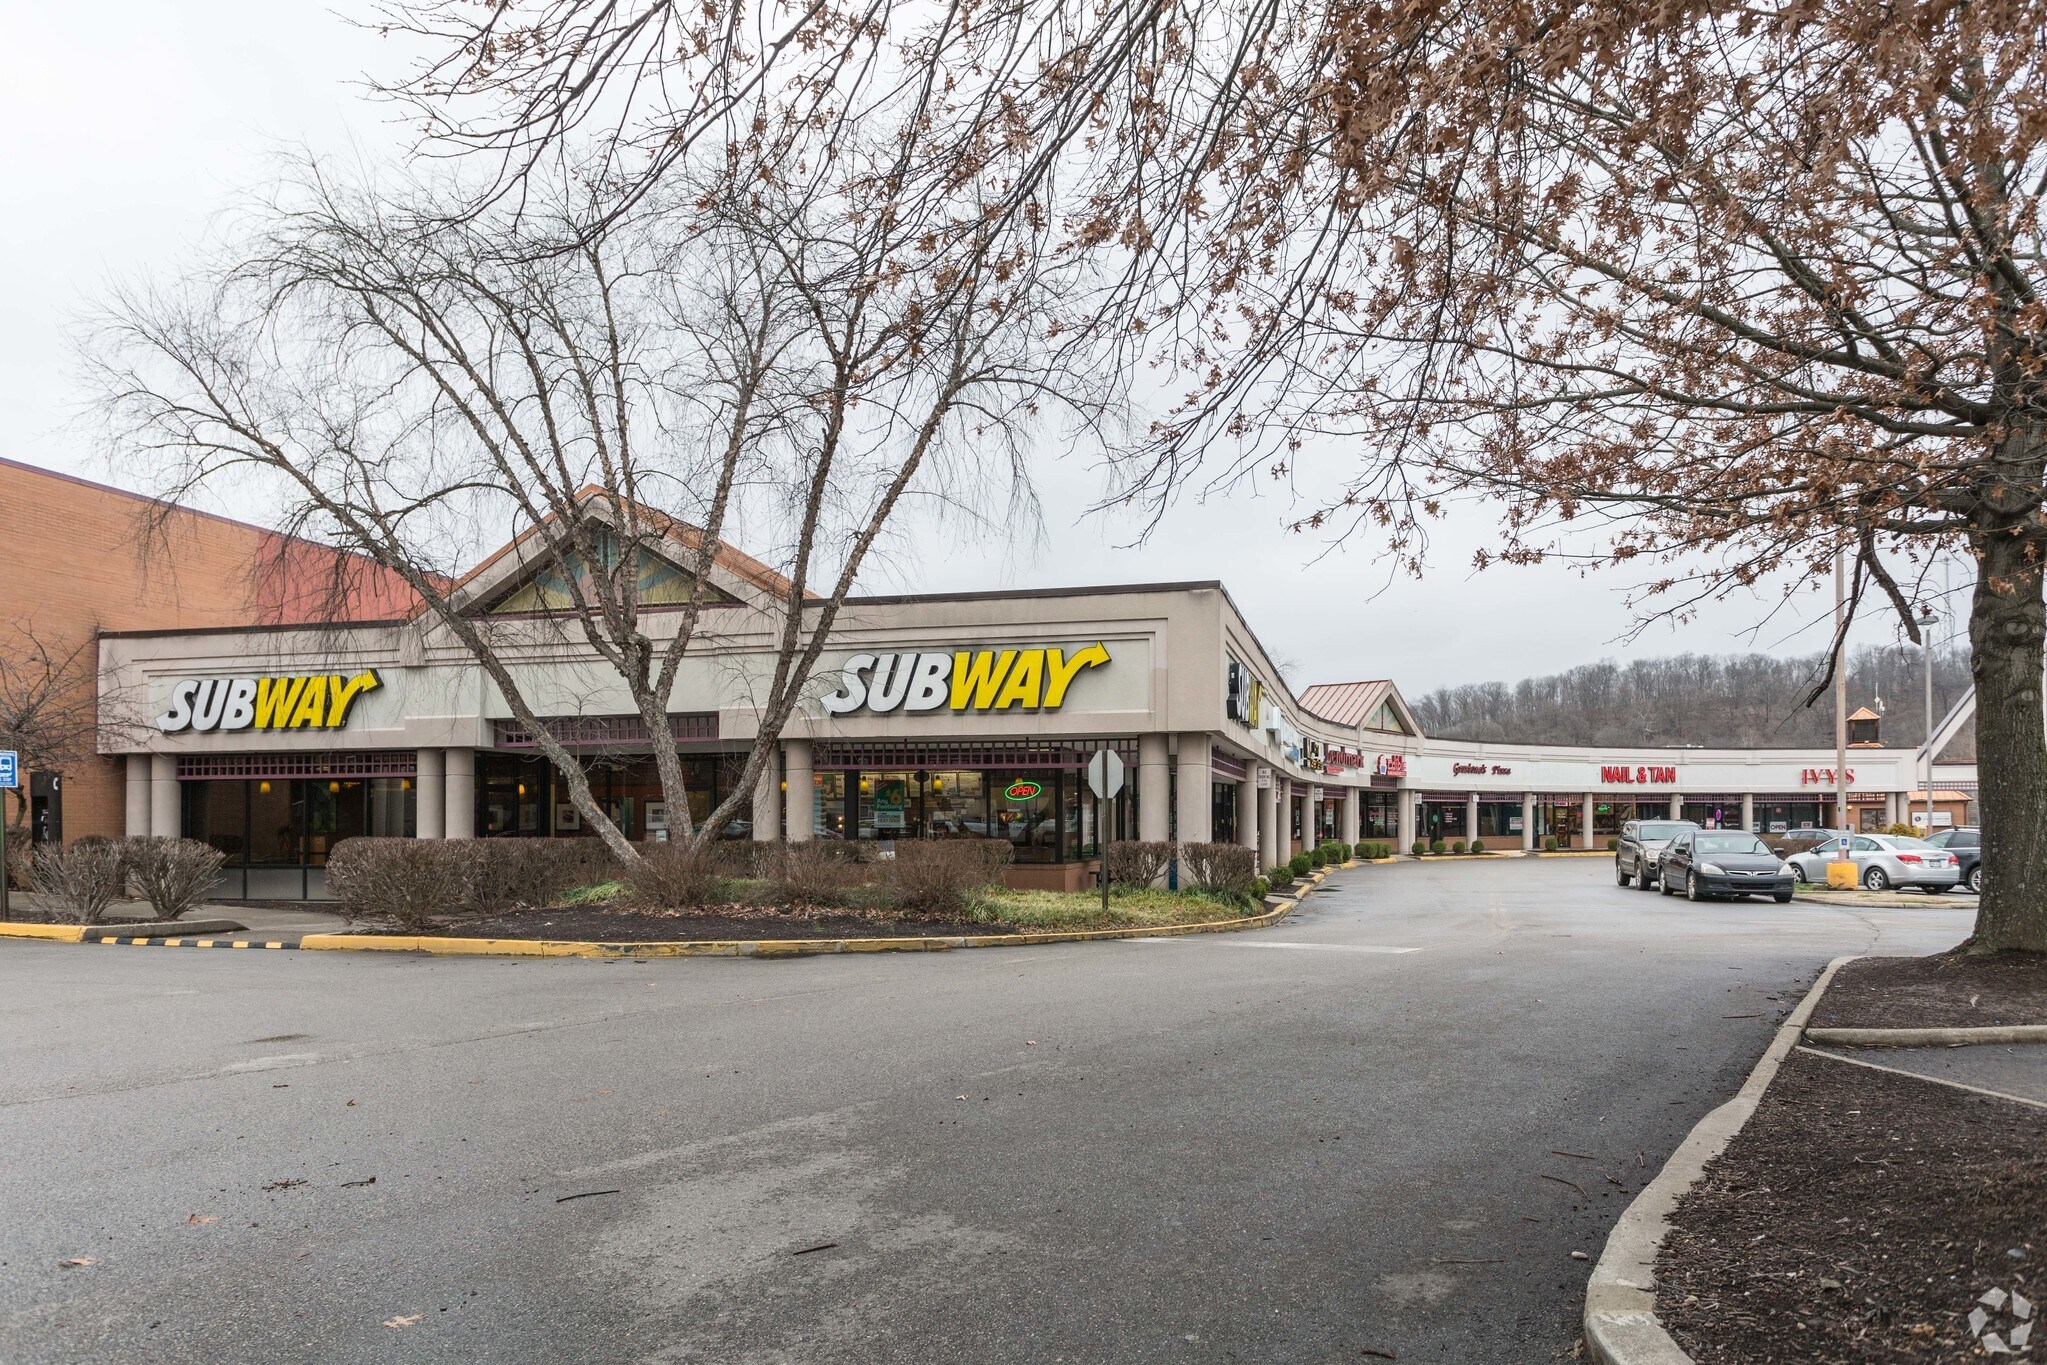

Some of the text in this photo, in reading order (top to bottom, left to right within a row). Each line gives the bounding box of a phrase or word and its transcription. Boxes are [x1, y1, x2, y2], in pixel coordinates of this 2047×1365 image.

[820, 641, 1112, 717] SUBWAY
[155, 668, 384, 732] SUBWAY
[1009, 785, 1036, 796] OPEN
[1601, 766, 1676, 783] NAIL & TAN
